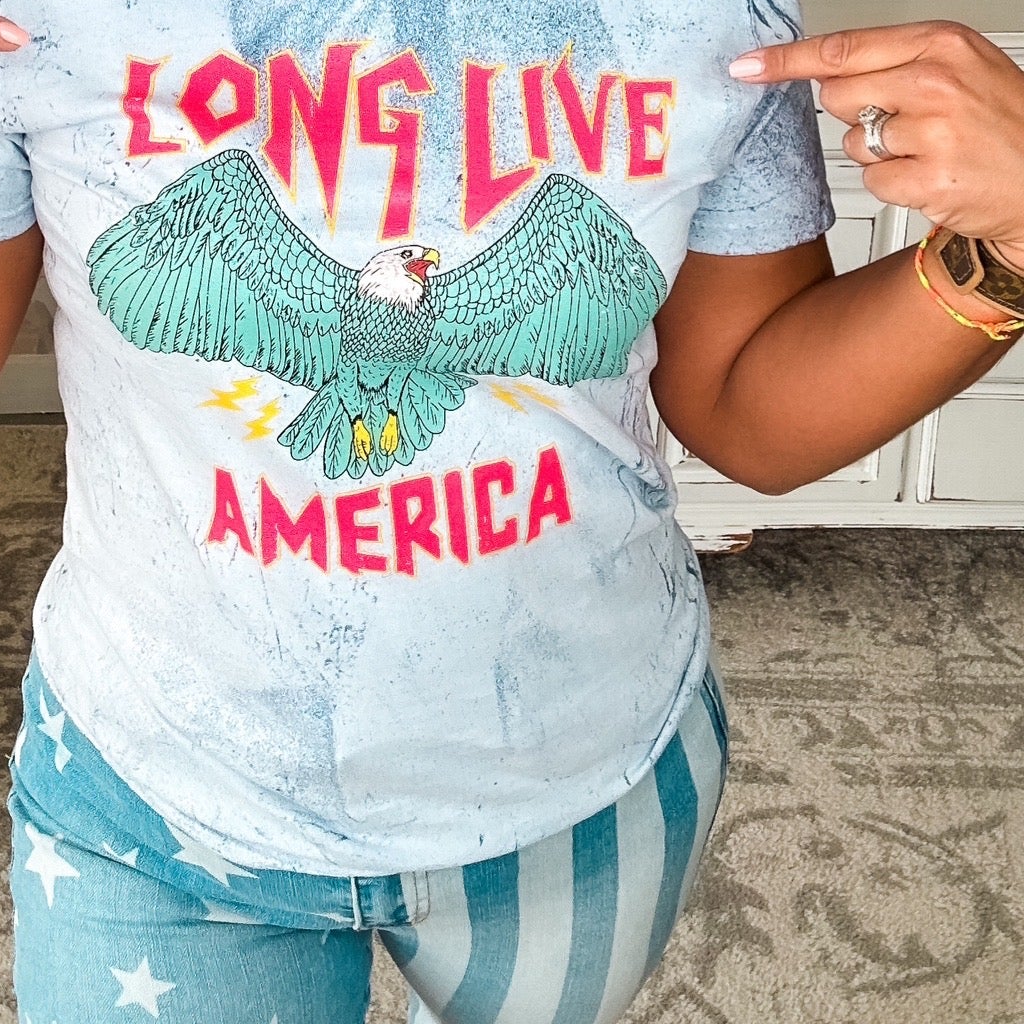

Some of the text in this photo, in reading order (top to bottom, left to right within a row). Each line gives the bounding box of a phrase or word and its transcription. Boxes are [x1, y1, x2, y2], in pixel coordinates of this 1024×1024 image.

[121, 38, 677, 240] LONG LIVE
[206, 443, 574, 579] AMERICA
